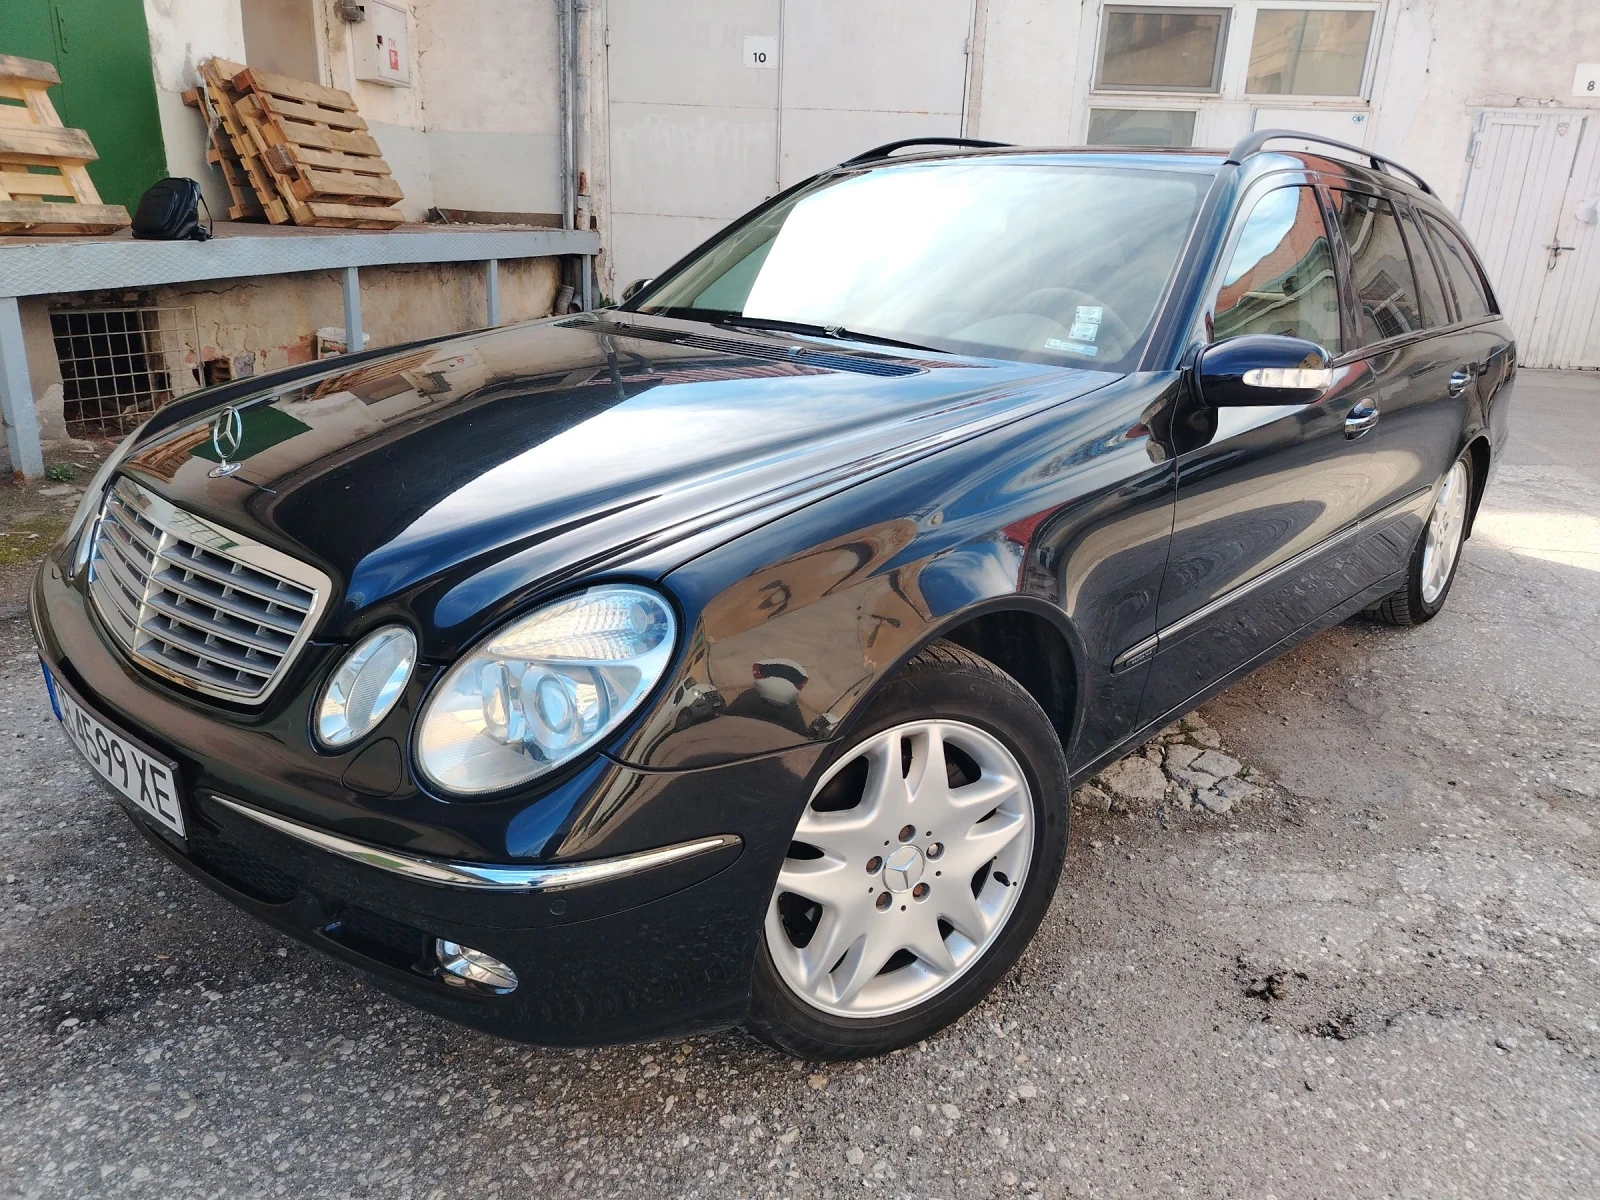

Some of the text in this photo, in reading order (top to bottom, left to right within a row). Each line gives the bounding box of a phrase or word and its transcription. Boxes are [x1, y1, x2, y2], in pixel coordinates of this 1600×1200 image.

[753, 52, 767, 63] 10
[1587, 80, 1595, 91] 8
[75, 707, 129, 789] 4599
[131, 751, 177, 824] XE
